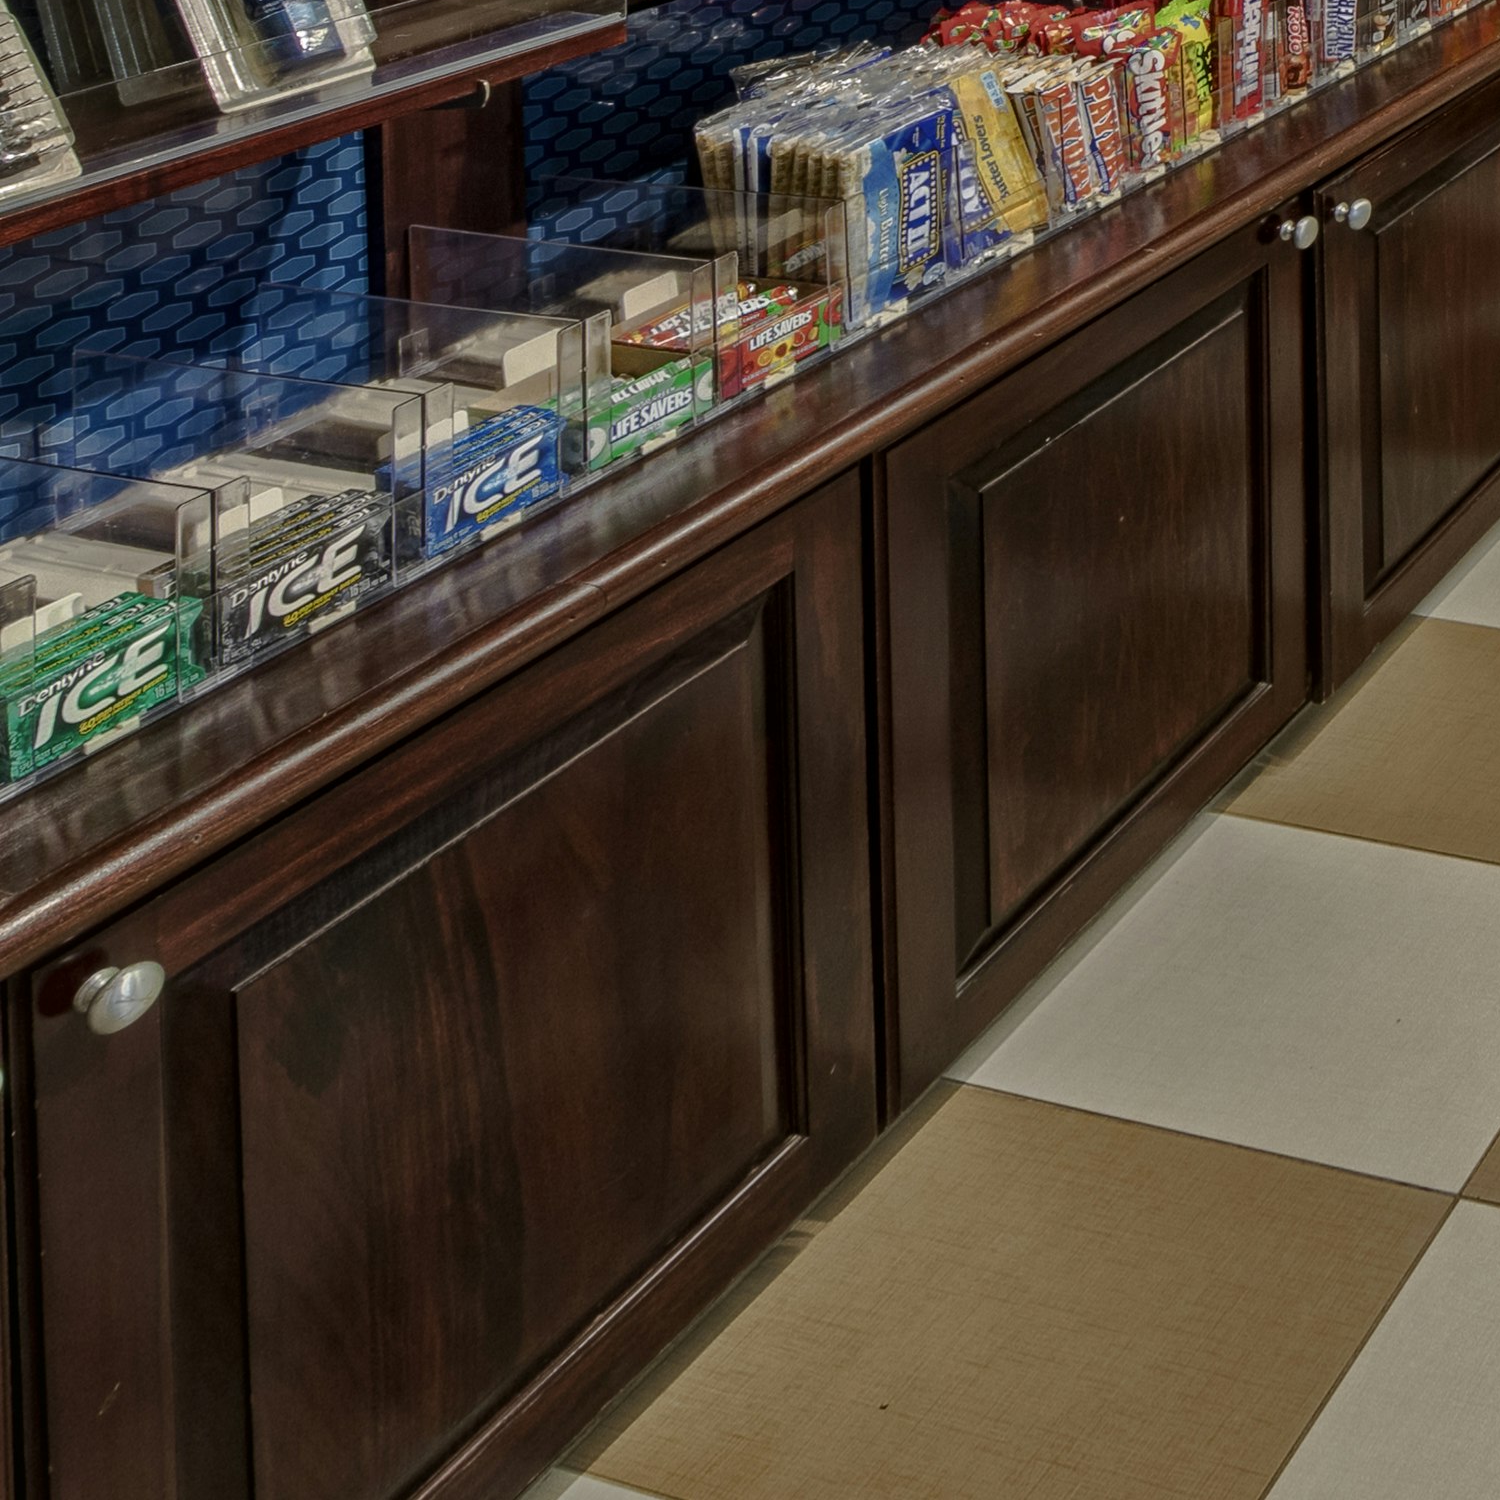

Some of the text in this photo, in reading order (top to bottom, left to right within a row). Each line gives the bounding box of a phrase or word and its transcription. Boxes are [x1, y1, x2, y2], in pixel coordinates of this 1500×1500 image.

[1287, 5, 1303, 55] ROLO
[1083, 76, 1120, 193] PAYDAY
[1128, 50, 1167, 168] Skittles
[907, 170, 931, 221] ACT
[879, 216, 894, 271] Butter
[432, 453, 498, 505] Dentyne
[444, 431, 545, 536] ICE
[230, 550, 308, 609] Dentyne
[243, 523, 366, 640] ICE
[18, 650, 106, 718] Dentyne
[33, 618, 172, 751] ICE
[154, 684, 165, 699] 16
